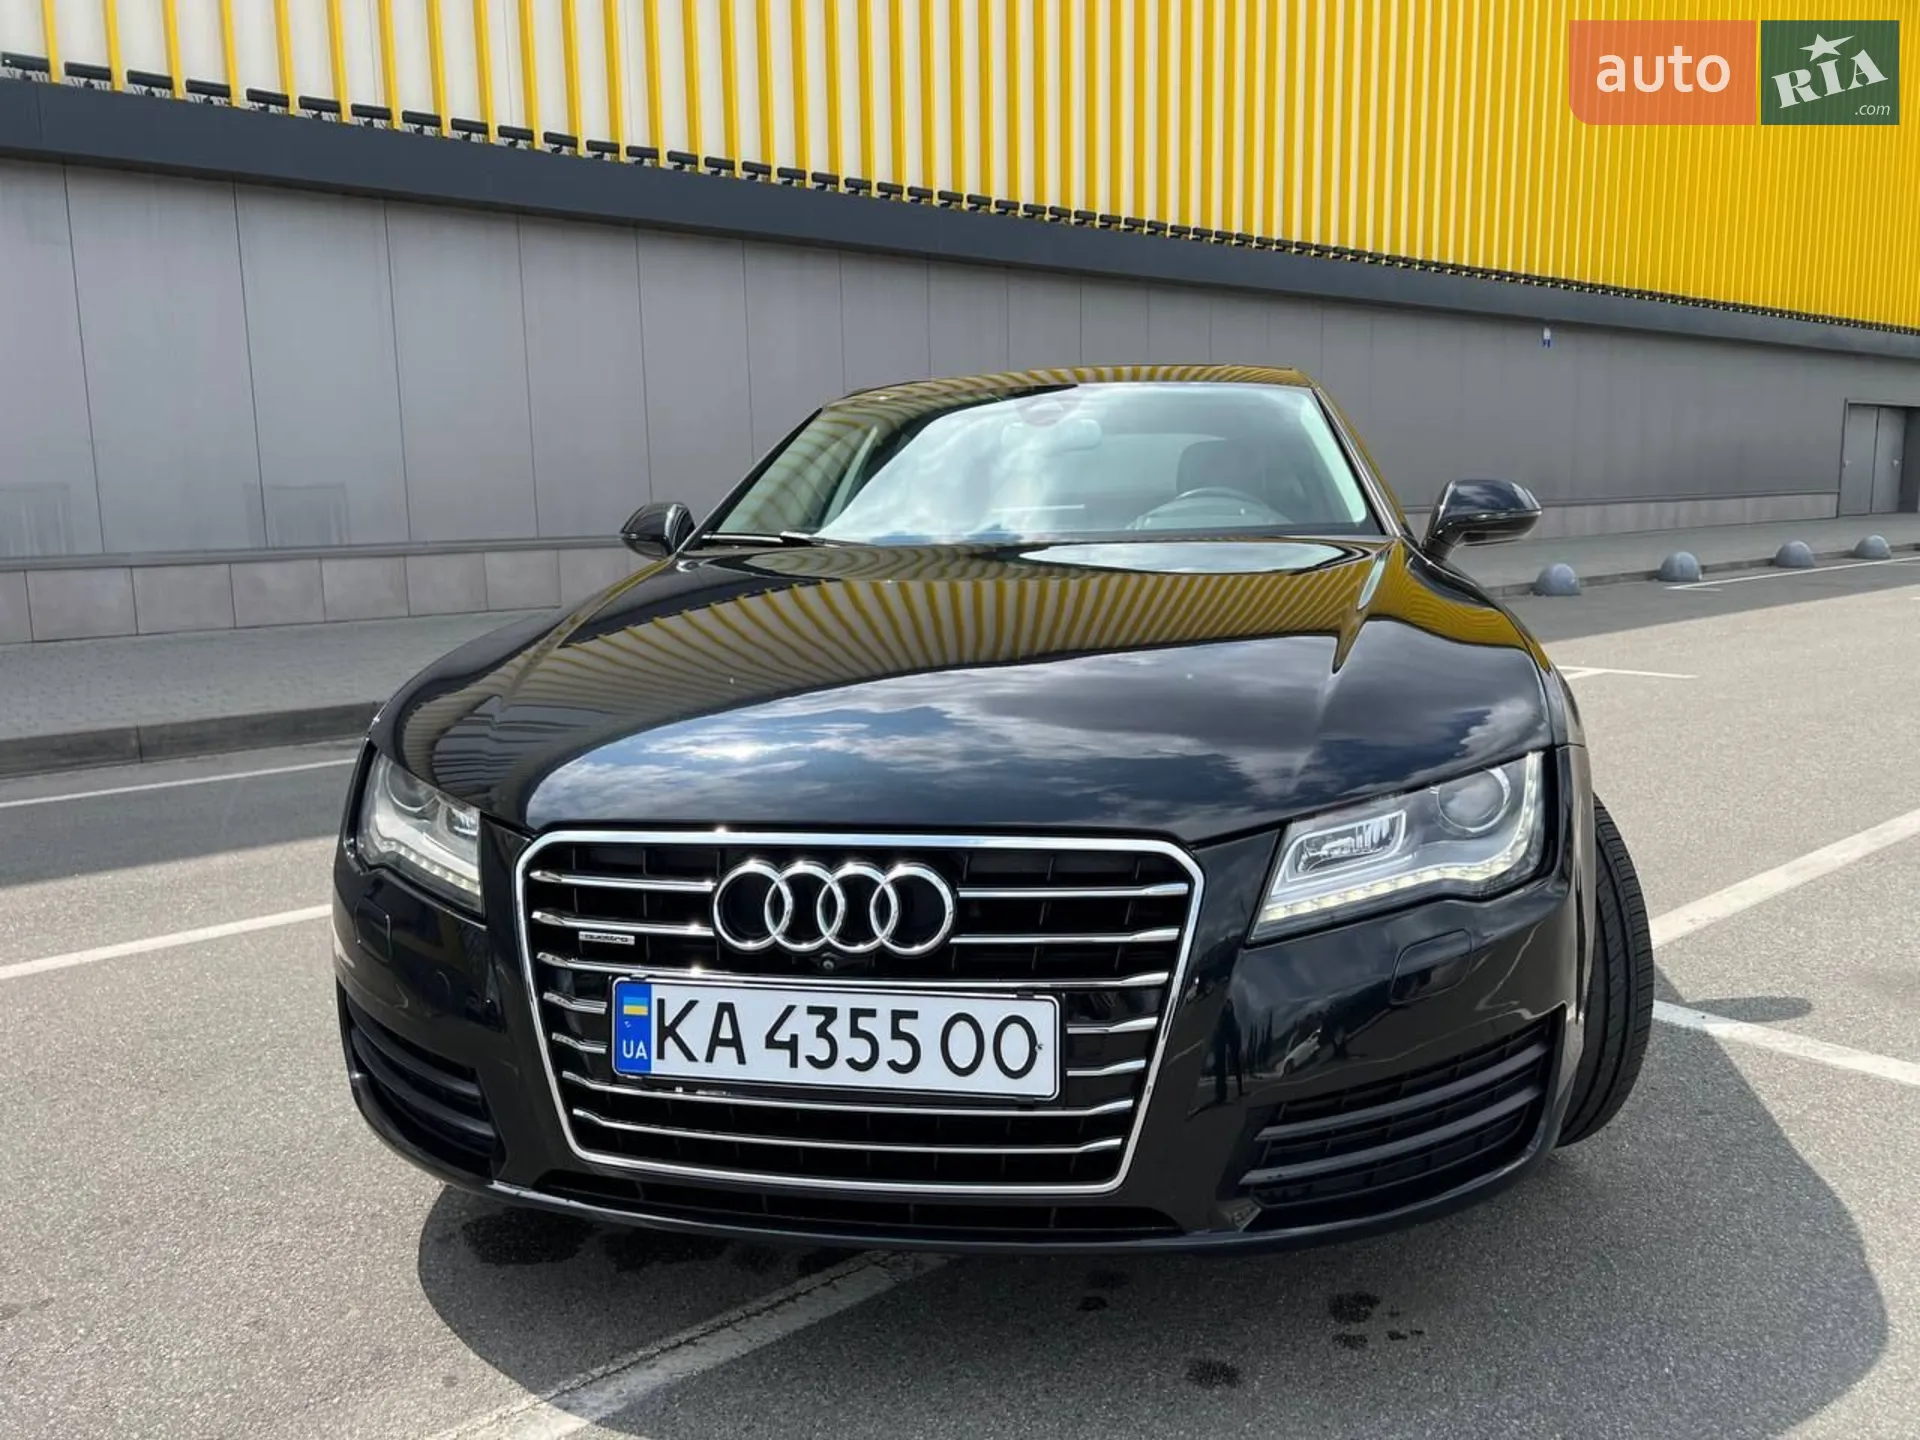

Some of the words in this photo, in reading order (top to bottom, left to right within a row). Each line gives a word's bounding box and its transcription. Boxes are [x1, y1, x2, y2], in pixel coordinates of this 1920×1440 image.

[622, 1039, 649, 1060] UA
[656, 997, 747, 1065] KA
[764, 1004, 922, 1074] 4355
